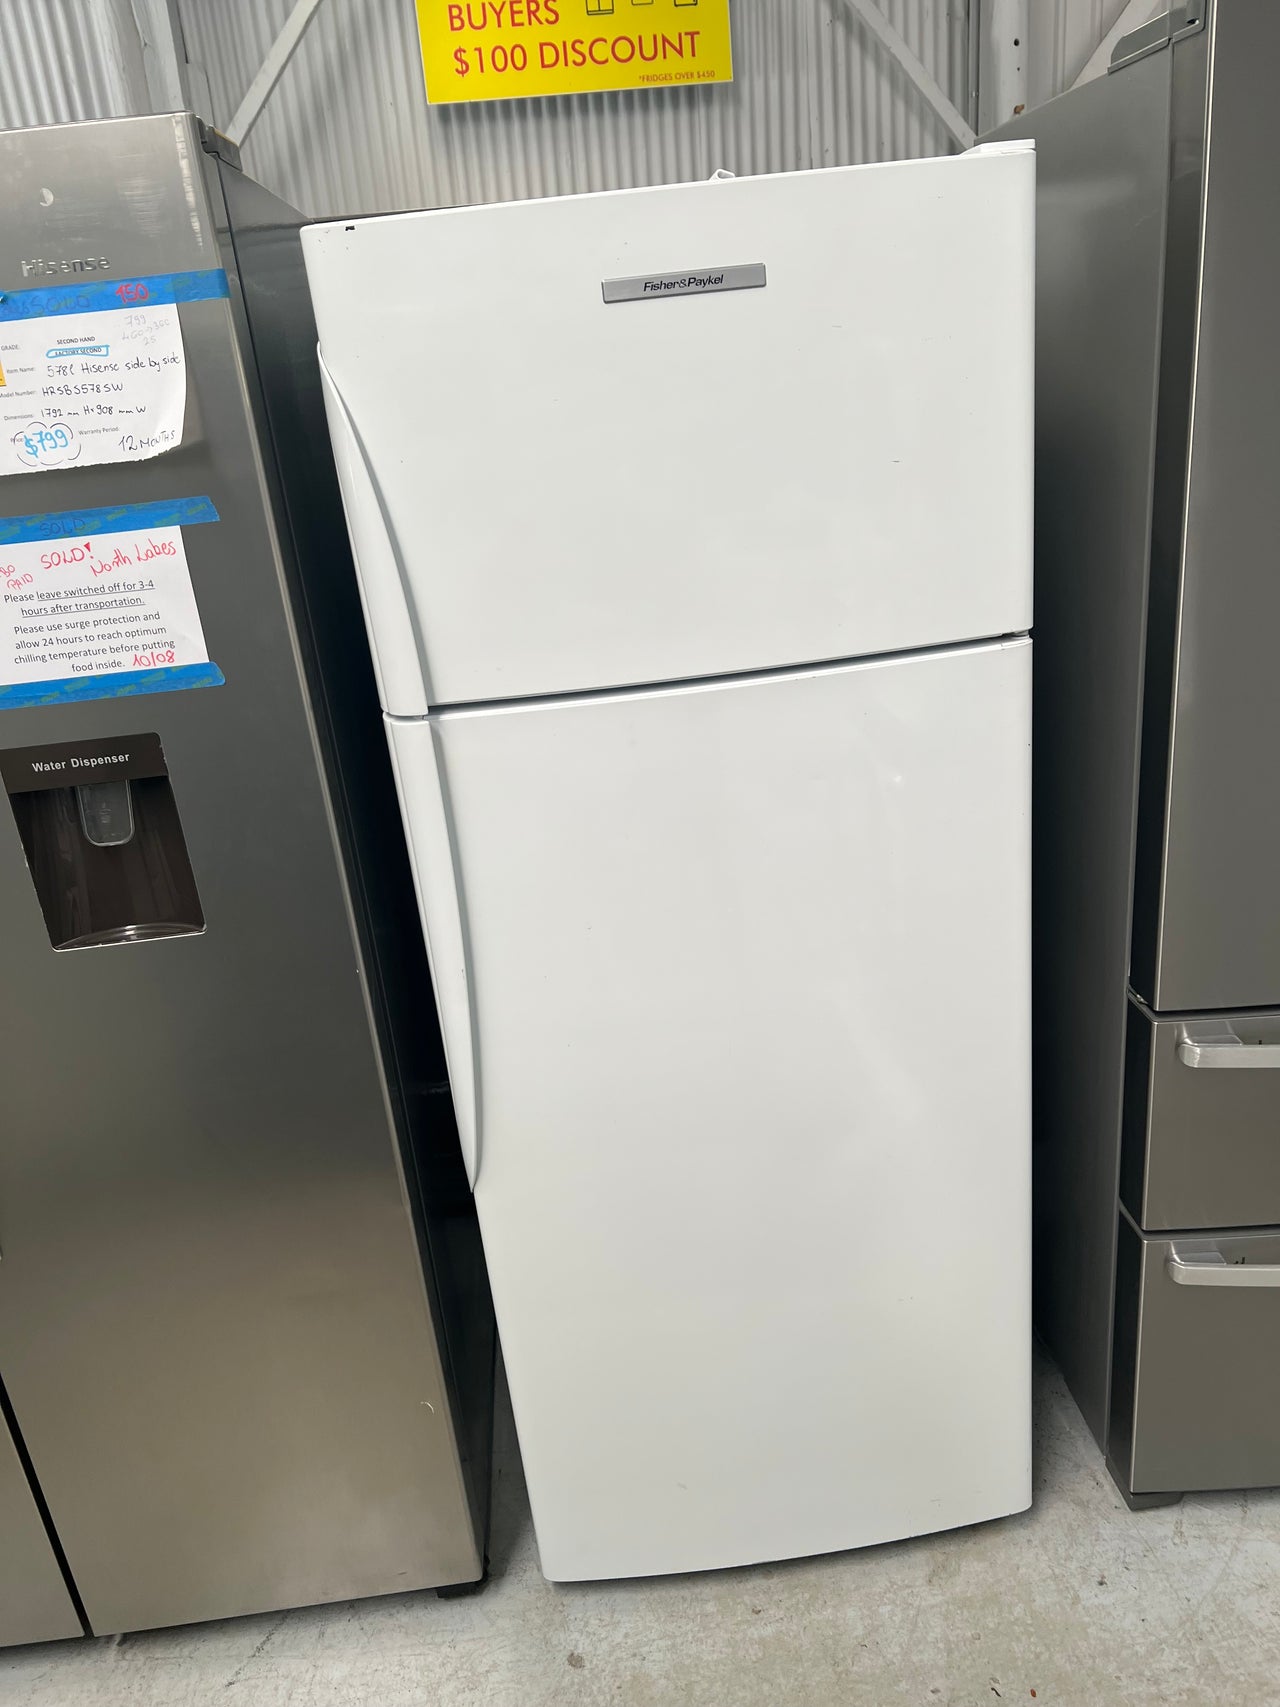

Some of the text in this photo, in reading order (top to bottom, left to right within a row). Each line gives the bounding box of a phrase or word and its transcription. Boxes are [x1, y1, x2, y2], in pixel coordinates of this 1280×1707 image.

[448, 0, 560, 31] BUYERS
[453, 31, 701, 77] $100 DISCOUNT
[675, 71, 695, 80] OVER
[697, 70, 715, 79] $450
[20, 256, 112, 277] Hisense
[644, 274, 724, 291] Fisher&Paykel
[115, 283, 149, 304] 150
[57, 337, 78, 345] SECOND
[81, 362, 119, 374] Hisense
[125, 356, 146, 370] side
[148, 357, 161, 372] by
[162, 352, 181, 364] side
[41, 408, 63, 418] 1792
[136, 405, 147, 414] W
[78, 428, 102, 436] Warranty
[118, 429, 175, 451] 12 MONTHS
[24, 428, 69, 458] $799
[41, 542, 94, 569] SOLD!
[90, 548, 132, 577] North
[4, 580, 154, 603] Please leave switched off for 3-4
[21, 596, 145, 616] hours after transportation.
[14, 625, 44, 634] Please
[64, 620, 90, 631] surge
[93, 614, 141, 628] protection
[143, 612, 161, 621] and
[15, 626, 166, 650] allow 24 hours to reach optimum
[14, 639, 175, 664] chilling temperature before putting
[132, 650, 175, 668] 10/08
[71, 659, 125, 672] food inside.
[32, 753, 130, 773] Water Dispenser
